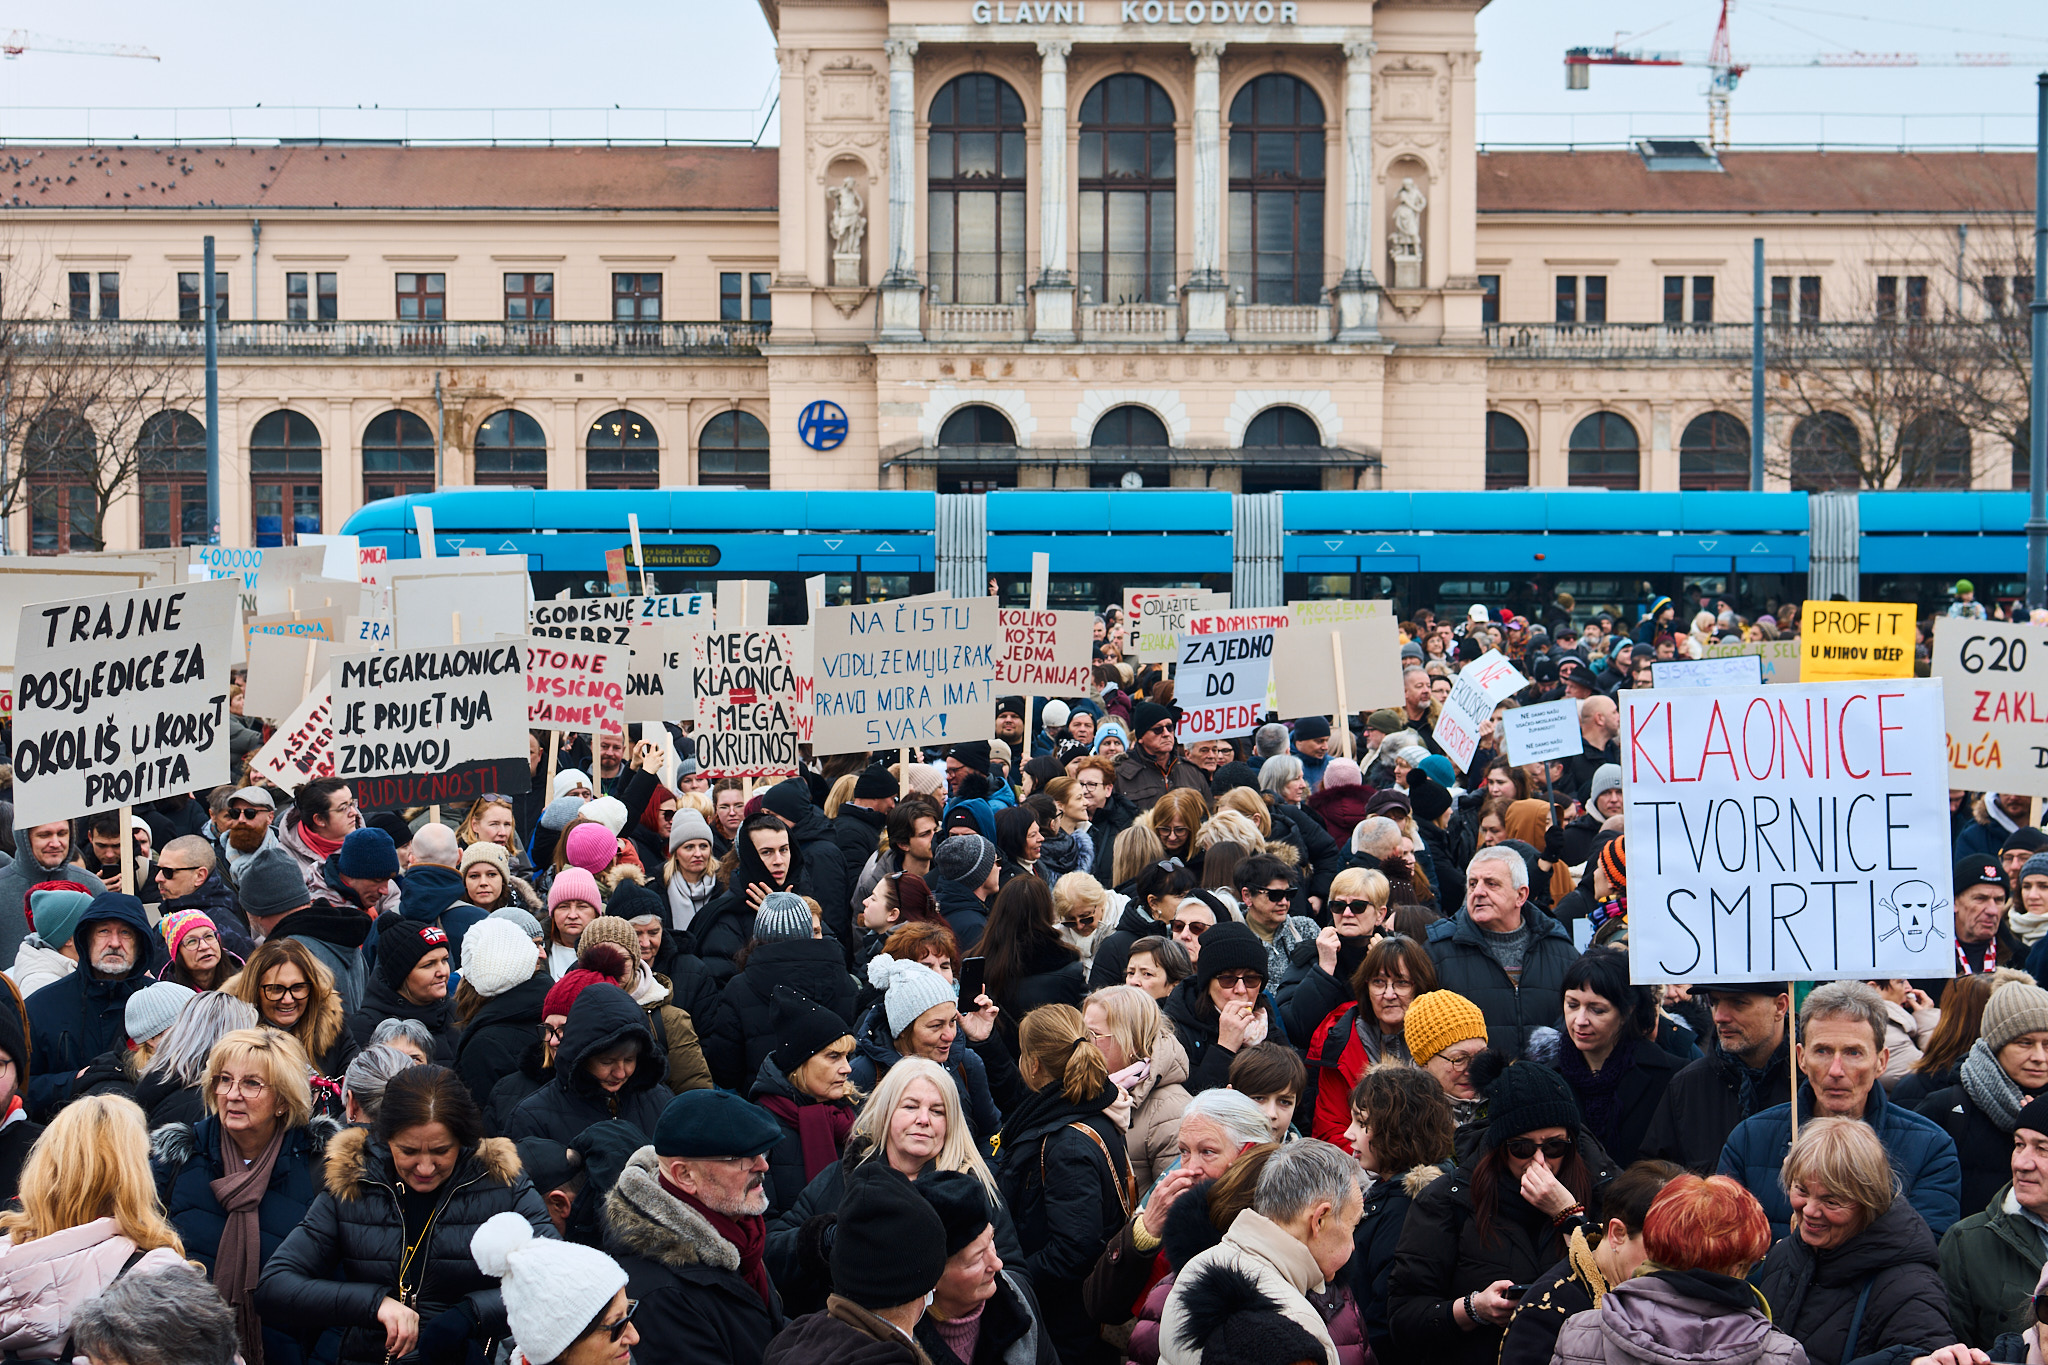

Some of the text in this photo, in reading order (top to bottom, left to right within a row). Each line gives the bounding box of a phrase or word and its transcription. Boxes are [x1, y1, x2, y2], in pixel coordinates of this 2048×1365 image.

[972, 0, 1299, 25] GLAVNI KOLODVOR
[199, 547, 263, 568] 400000
[42, 591, 187, 649] TRAJNE
[535, 594, 702, 625] GODIŠNJE ŽELE
[850, 603, 970, 636] NA ČISTU
[999, 609, 1057, 627] KOLIKO
[1812, 610, 1904, 635] PROFIT
[287, 621, 325, 635] TONA
[1005, 628, 1057, 645] KOŠTA
[1190, 617, 1213, 636] NE
[169, 642, 205, 684] ZA
[706, 632, 782, 665] MEGA
[1003, 646, 1055, 663] JEDNA
[1183, 633, 1274, 666] ZAJEDNO
[1811, 645, 1819, 659] U
[1823, 645, 1869, 660] NJIHOV
[1960, 635, 2027, 674] 620
[340, 645, 522, 689] MEGAKLAONICA
[693, 665, 797, 699] KLAONICA
[995, 660, 1090, 693] ŽUPANIJA?
[1474, 660, 1513, 690] NE
[816, 689, 866, 717] PRAVO
[877, 684, 932, 713] MORA
[1205, 672, 1235, 697] DO
[338, 700, 366, 736] JE
[717, 701, 790, 733] MEGA
[867, 713, 948, 745] SVAK!
[1177, 702, 1262, 737] POBJEDE
[14, 712, 121, 784] OKOLIŠ
[154, 694, 227, 753] KORIST
[696, 731, 799, 769] OKRUTNOST
[1630, 692, 1913, 784] KLAONICE
[340, 738, 450, 775] ZDRAVOJ
[85, 753, 191, 808] PROFITA
[1633, 792, 1918, 875] TVORNICE
[1658, 878, 1877, 977] SMRTI
